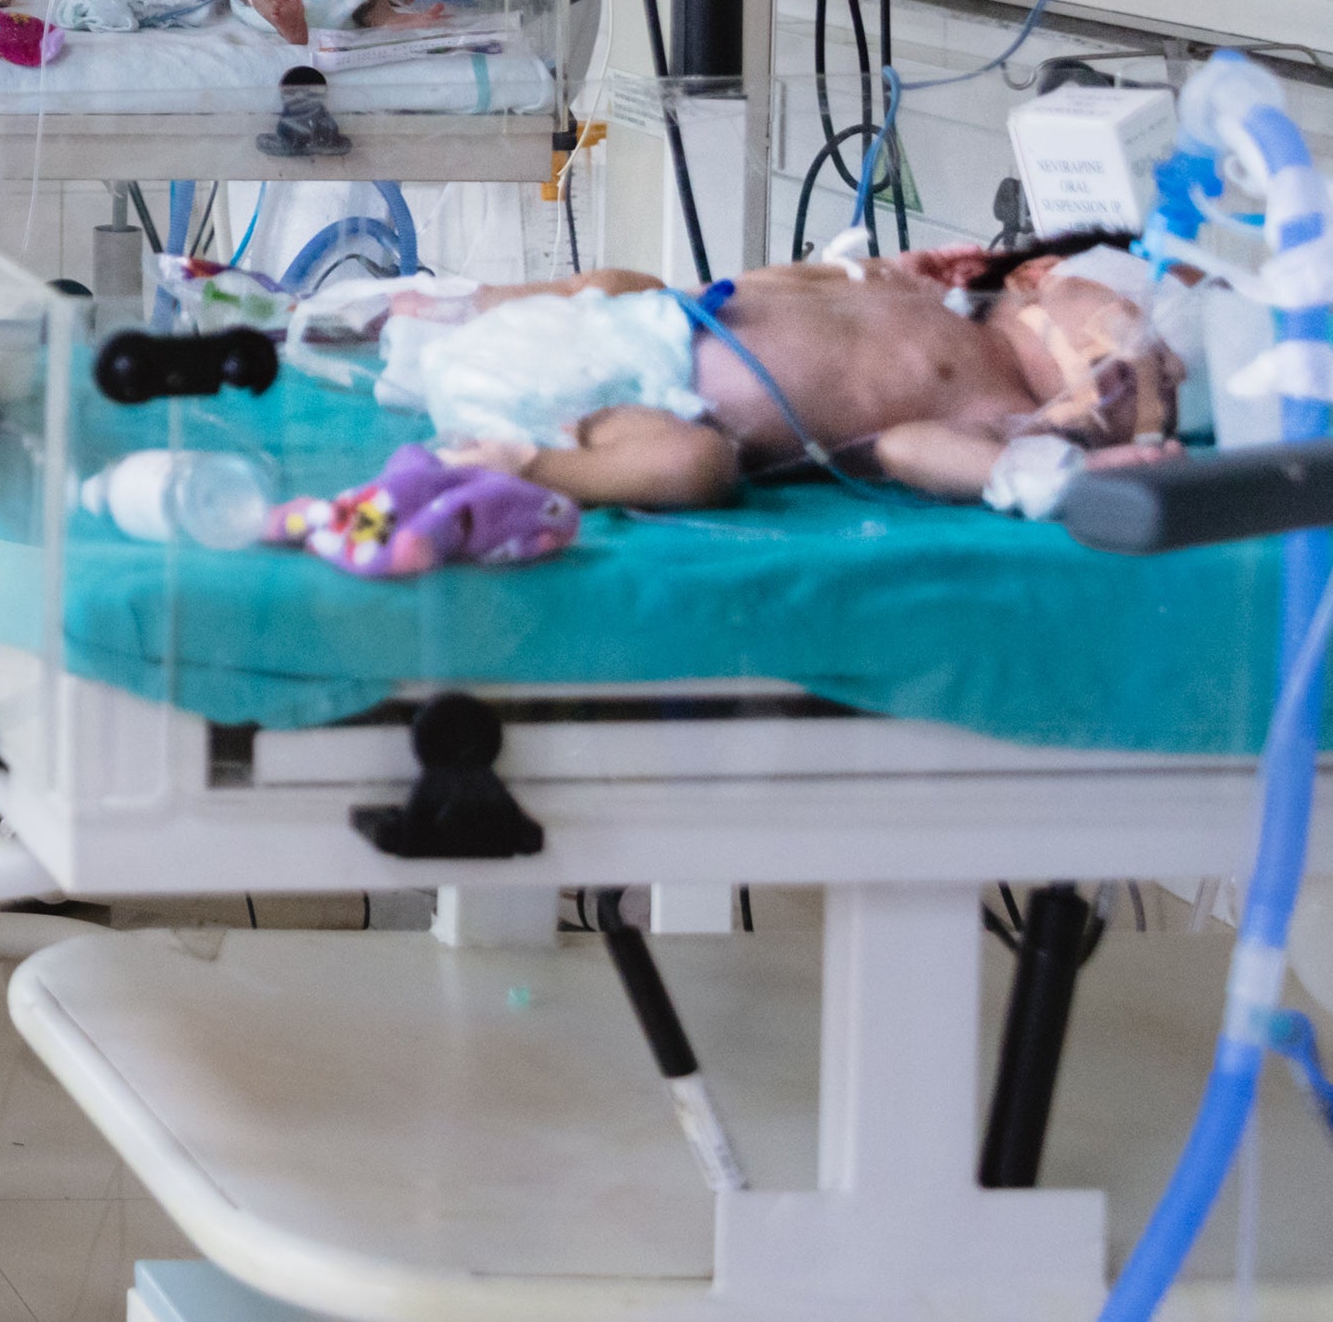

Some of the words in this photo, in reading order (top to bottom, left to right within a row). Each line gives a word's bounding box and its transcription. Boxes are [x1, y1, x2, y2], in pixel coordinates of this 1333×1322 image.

[1036, 159, 1105, 174] NEVIRAPINE
[1059, 180, 1091, 194] ORAL
[1041, 199, 1107, 213] SUSPENSION
[1111, 202, 1123, 214] IP
